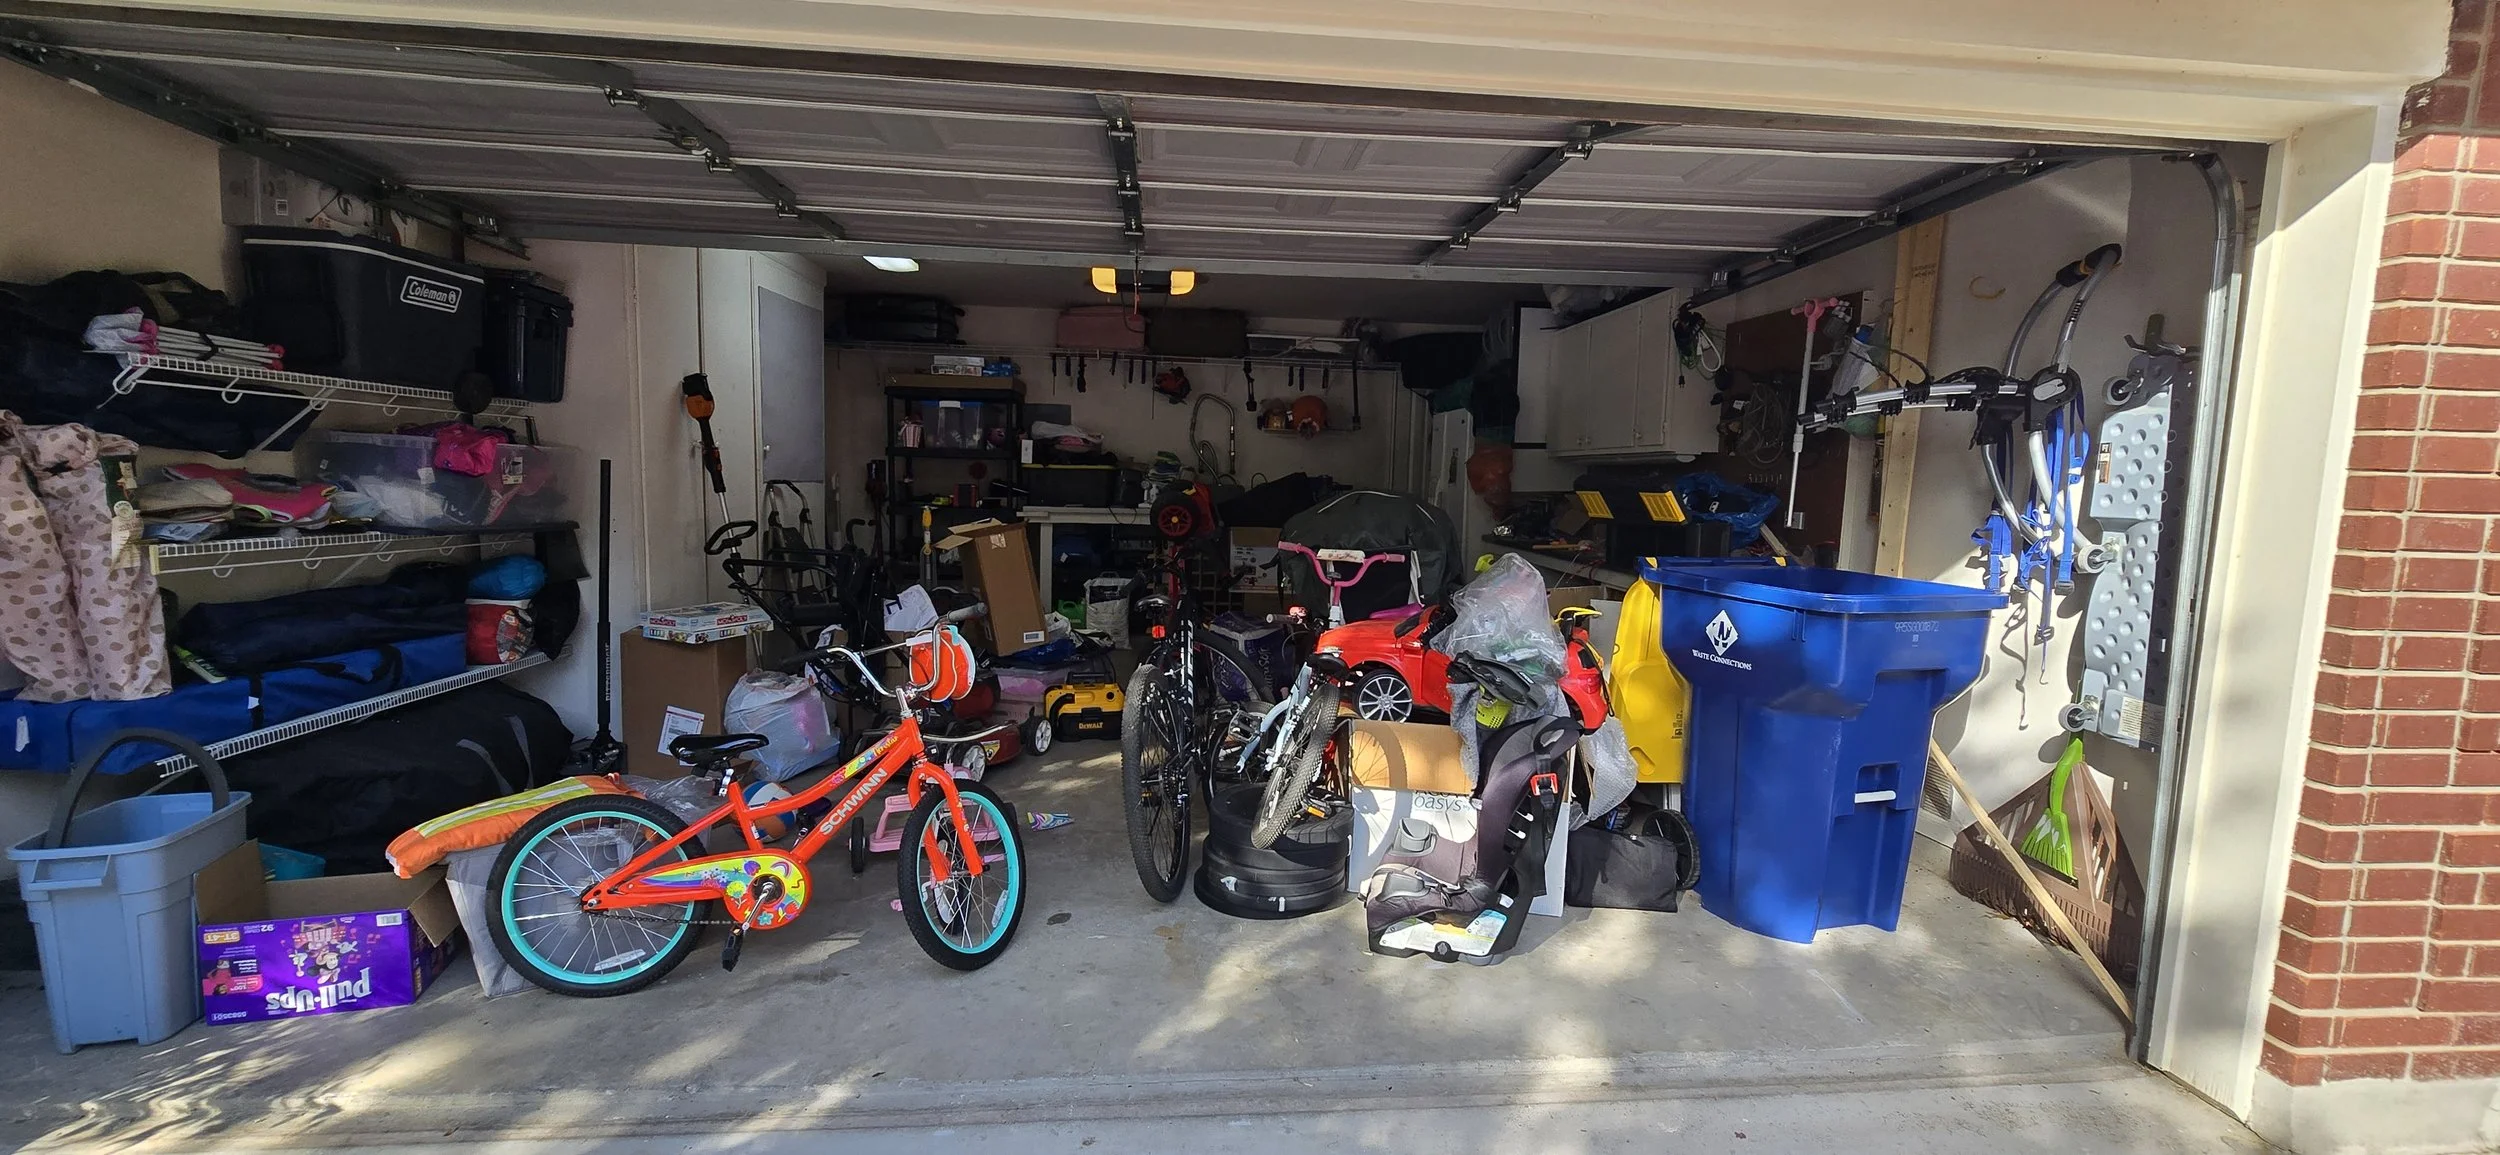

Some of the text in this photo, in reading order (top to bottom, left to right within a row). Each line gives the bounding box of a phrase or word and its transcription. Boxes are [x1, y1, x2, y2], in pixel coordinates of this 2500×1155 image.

[409, 281, 448, 302] Coleman
[649, 617, 676, 626] MONOPOLY
[717, 615, 748, 625] MONOPOLY
[1692, 649, 1752, 671] WASTE CONNECTIONS
[819, 767, 888, 835] SCHWINN
[1414, 795, 1463, 812] oasys
[260, 924, 275, 932] 92
